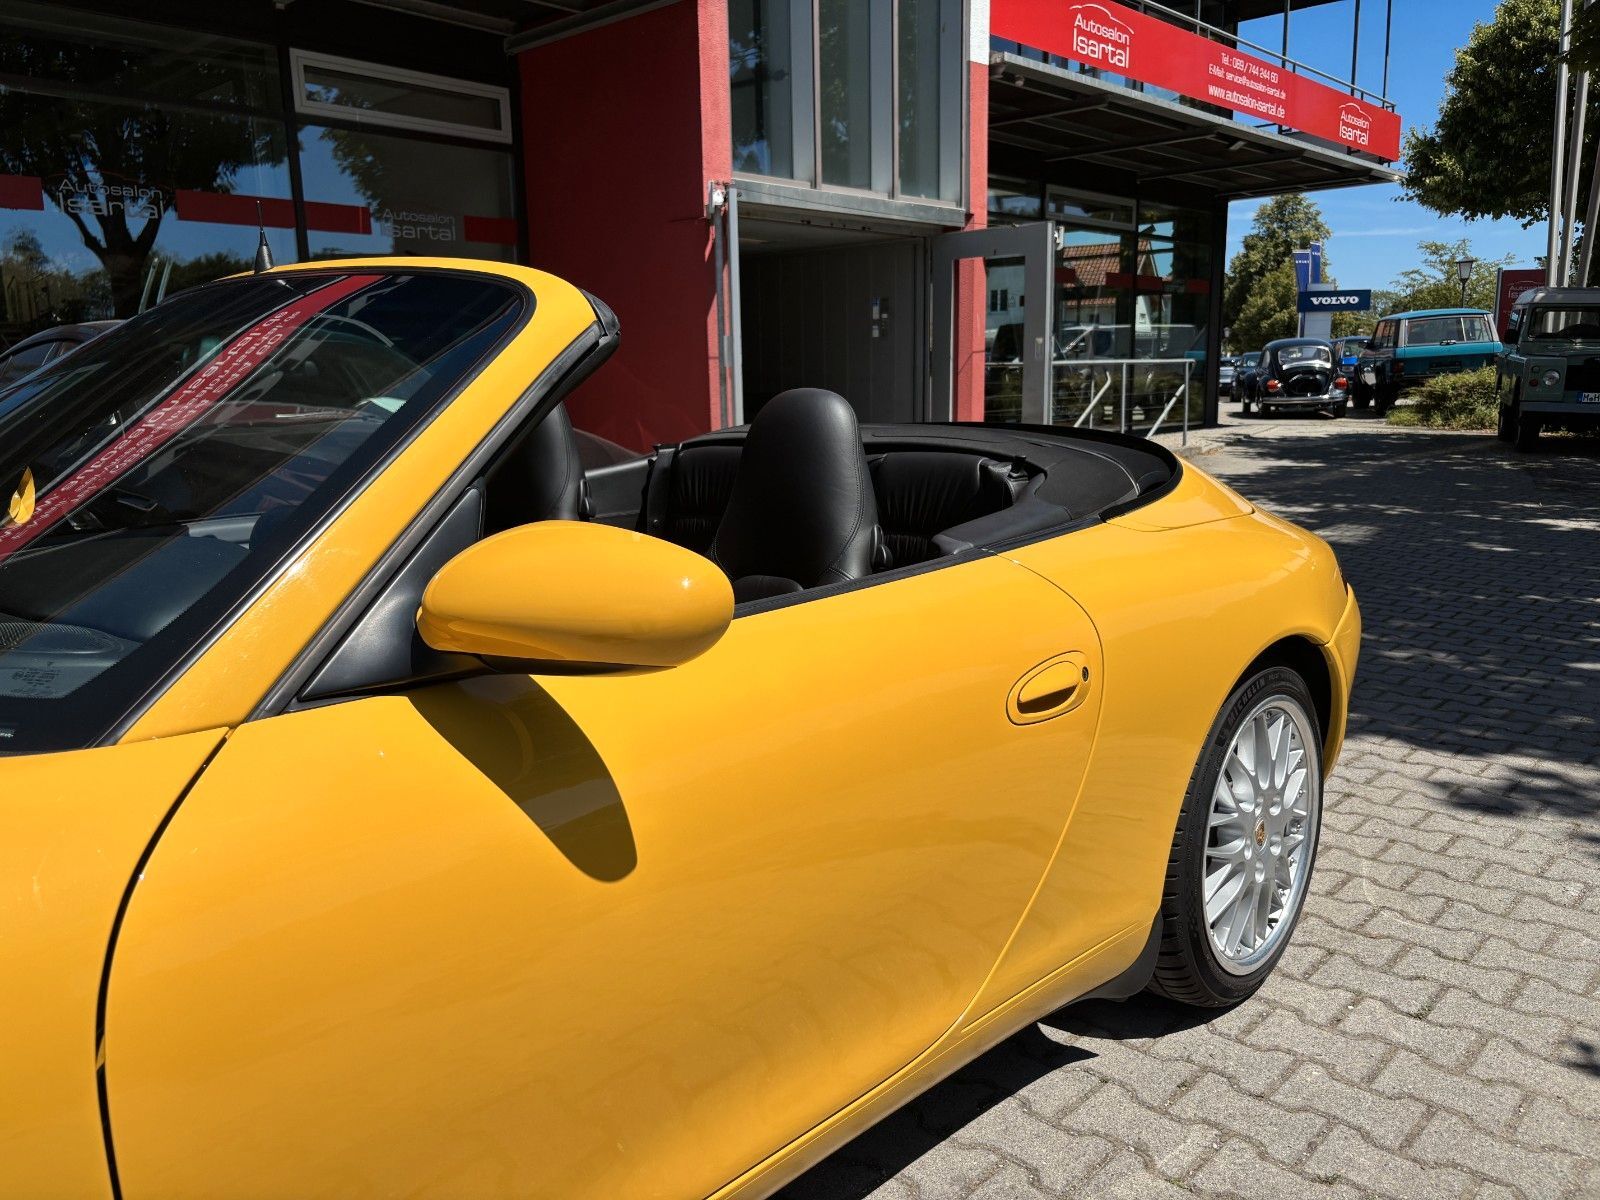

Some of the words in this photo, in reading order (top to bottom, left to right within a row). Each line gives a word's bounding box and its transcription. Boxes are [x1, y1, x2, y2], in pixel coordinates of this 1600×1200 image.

[1074, 13, 1130, 46] Autosalon
[1073, 27, 1130, 69] Isartal
[1232, 57, 1244, 71] 089
[1244, 63, 1248, 73] /
[1249, 62, 1259, 77] 744
[1260, 67, 1270, 81] 244
[1271, 72, 1279, 84] 60
[1208, 84, 1285, 119] www.autosalon-isartal.de
[1339, 120, 1369, 146] Isartal
[1341, 110, 1370, 130] Autosalon
[59, 178, 163, 199] Autosalon
[58, 191, 164, 219] Isartal
[382, 208, 456, 225] Autosalon
[1310, 295, 1360, 305] VOLVO
